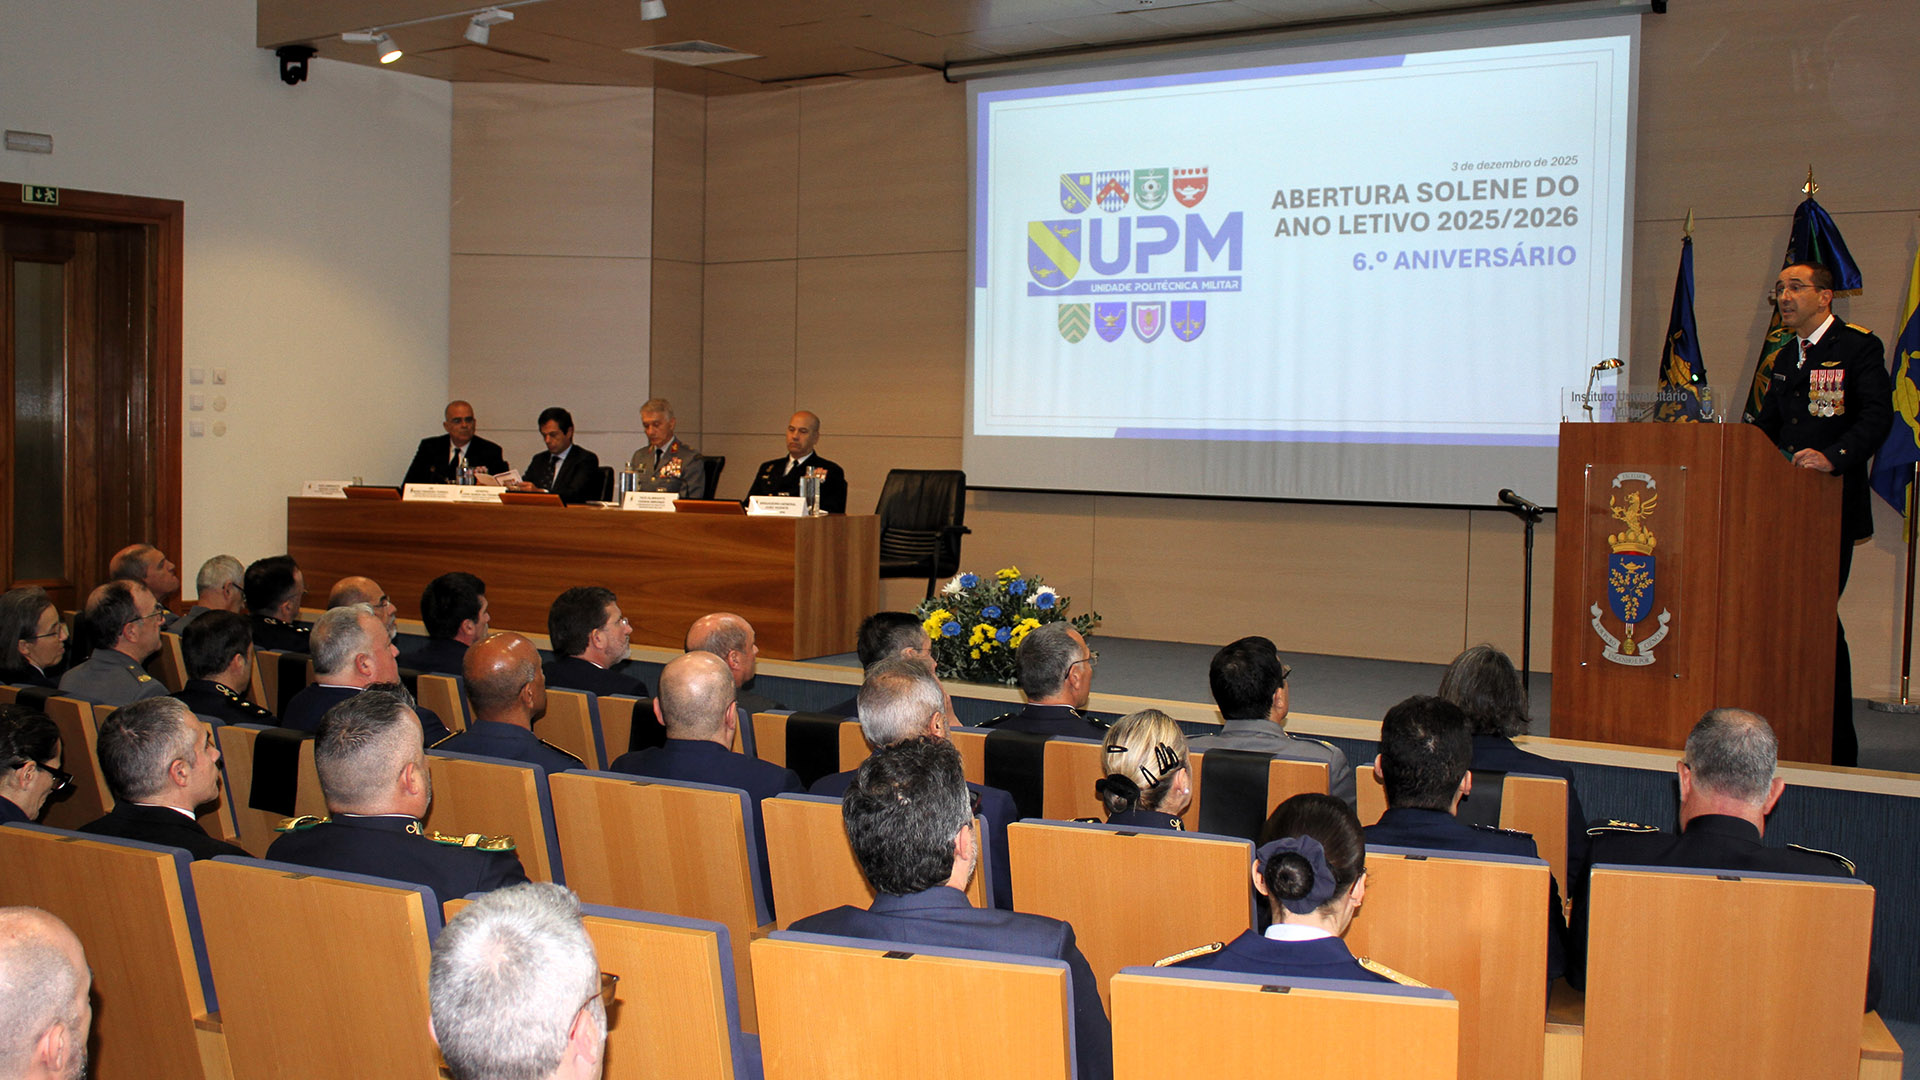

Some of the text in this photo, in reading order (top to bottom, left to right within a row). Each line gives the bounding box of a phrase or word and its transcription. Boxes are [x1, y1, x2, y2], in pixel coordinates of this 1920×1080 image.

[1451, 155, 1578, 171] 3 de dezembro de 2025
[1271, 175, 1579, 210] ABERTURA SOLENE DO
[1274, 206, 1579, 238] ANO LETIVO 2025/2026
[1089, 211, 1243, 275] UPM
[1393, 241, 1577, 271] ANIVERSÁRIO
[1090, 279, 1239, 293] UNIDADE POLITÉCNICA MILITAR
[1571, 390, 1614, 402] Instituto
